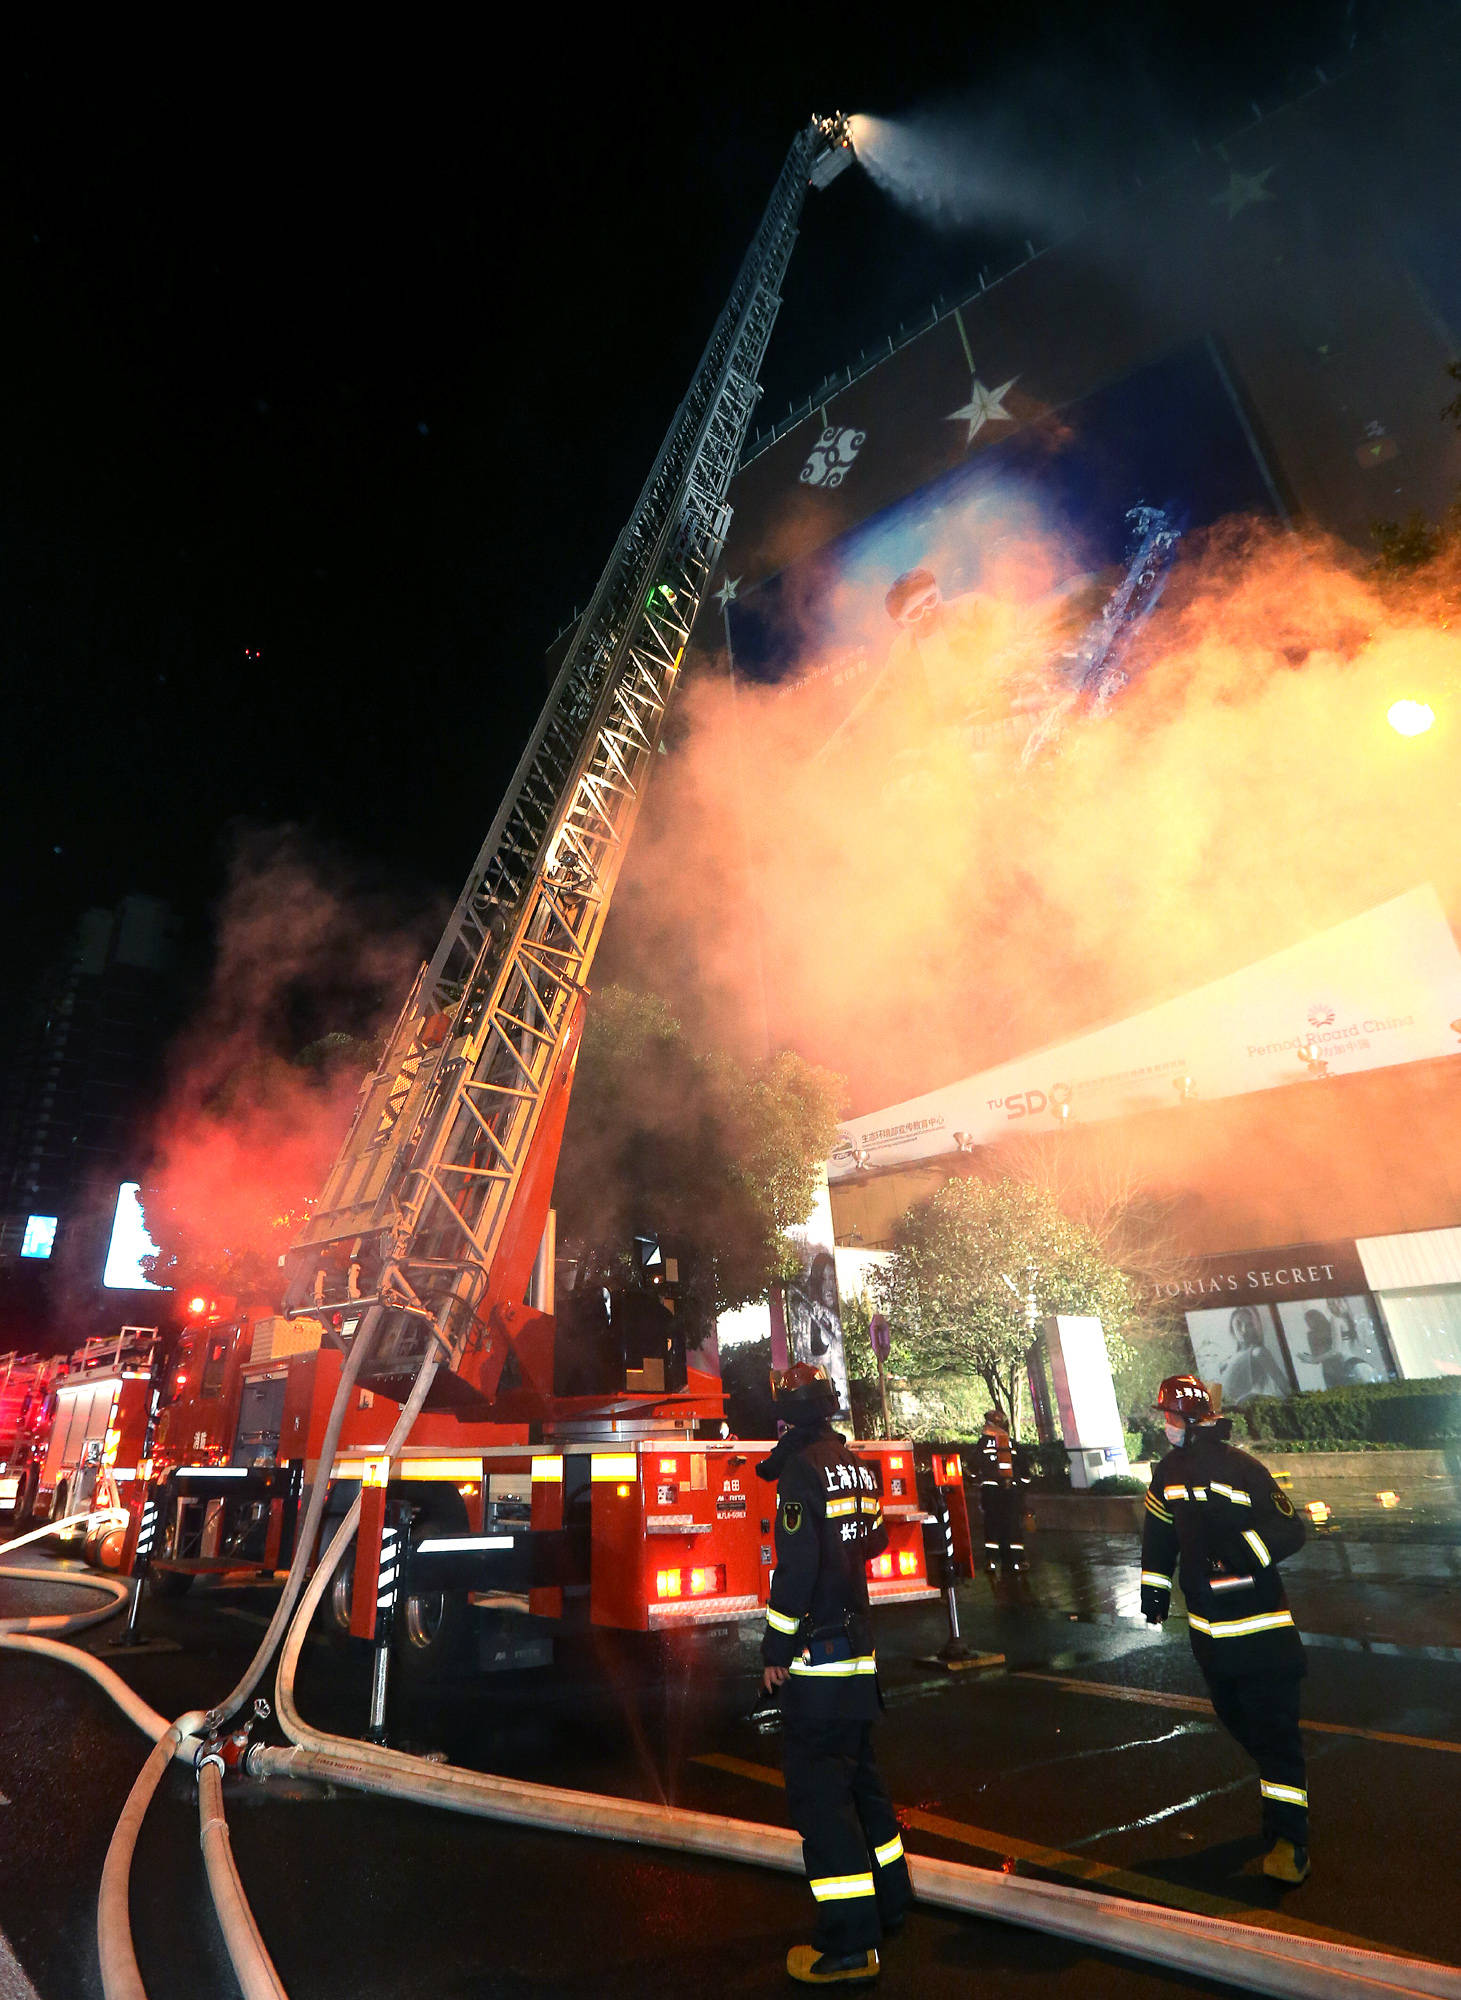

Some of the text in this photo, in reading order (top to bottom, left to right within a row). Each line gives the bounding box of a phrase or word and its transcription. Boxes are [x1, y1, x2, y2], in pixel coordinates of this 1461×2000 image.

[1247, 1015, 1415, 1058] Pernod Ricard China
[1153, 1264, 1335, 1298] TORIA'S SECRET
